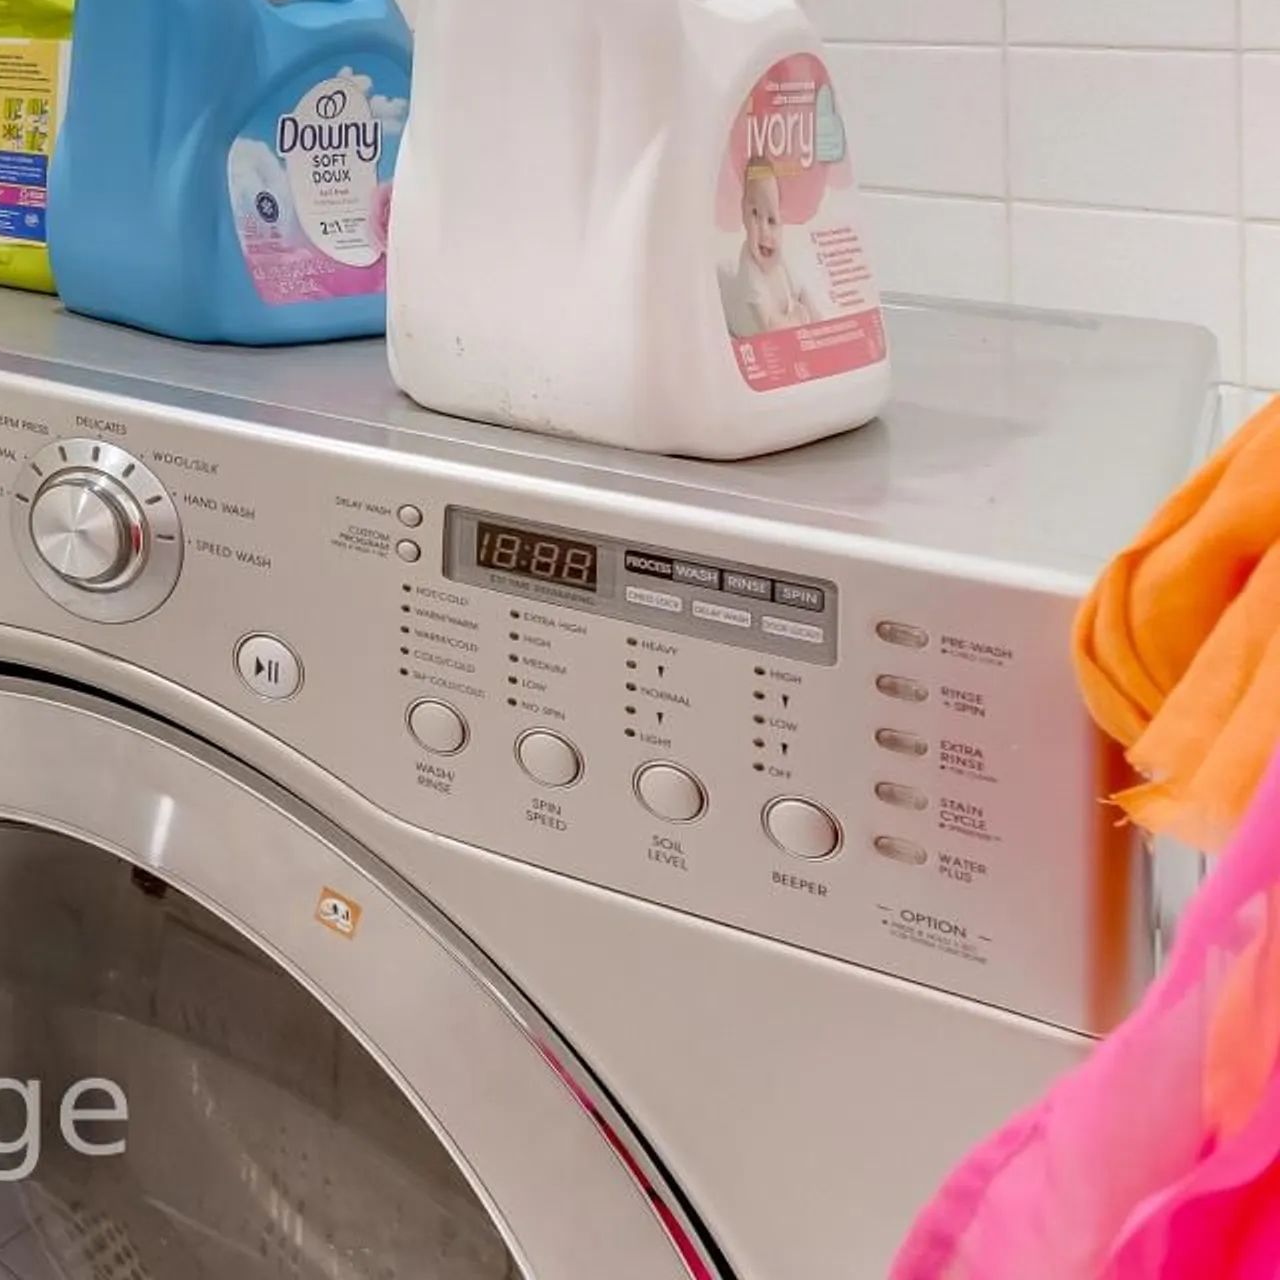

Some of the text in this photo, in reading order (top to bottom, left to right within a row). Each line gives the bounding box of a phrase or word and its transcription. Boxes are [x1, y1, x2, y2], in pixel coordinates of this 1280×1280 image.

[279, 117, 379, 162] Downy
[312, 154, 347, 168] SOFT
[313, 170, 351, 184] DOUX
[21, 419, 50, 436] PRESS
[76, 415, 127, 436] DELICATES
[153, 452, 218, 474] WOOL/SILK
[184, 494, 256, 520] HAND WASH
[196, 539, 272, 569] SPEED WASH
[626, 555, 819, 606] PROCESS WASH RINSE SPIN
[416, 586, 469, 607] HOT/COLD
[523, 611, 588, 636] EXTRA HIGH
[523, 634, 551, 649] HIGH
[641, 640, 678, 656] HEAVY
[941, 634, 1013, 659] PRE-WASH
[522, 656, 568, 676] MEDIUM
[521, 678, 548, 693] LOW
[770, 670, 802, 685] HIGH
[640, 686, 691, 708] NORMAL
[941, 685, 984, 705] RINSE
[541, 704, 566, 721] SPIN
[953, 701, 986, 718] SPIN
[770, 719, 798, 733] LOW
[639, 732, 671, 749] LIGHT
[940, 739, 984, 758] EXTRA
[415, 761, 455, 782] WASH/
[940, 752, 985, 771] RINSE
[768, 766, 793, 779] OFF
[417, 775, 453, 796] RINSE
[531, 797, 562, 816] SPIN
[940, 797, 984, 818] STAIN
[525, 809, 568, 832] SPEED
[940, 809, 987, 831] CYCLE
[651, 834, 684, 855] SOIL
[647, 849, 688, 872] LEVEL
[939, 851, 987, 874] WATER
[772, 871, 828, 898] BEEPER
[939, 865, 973, 884] PLUS
[899, 909, 967, 938] OPTION
